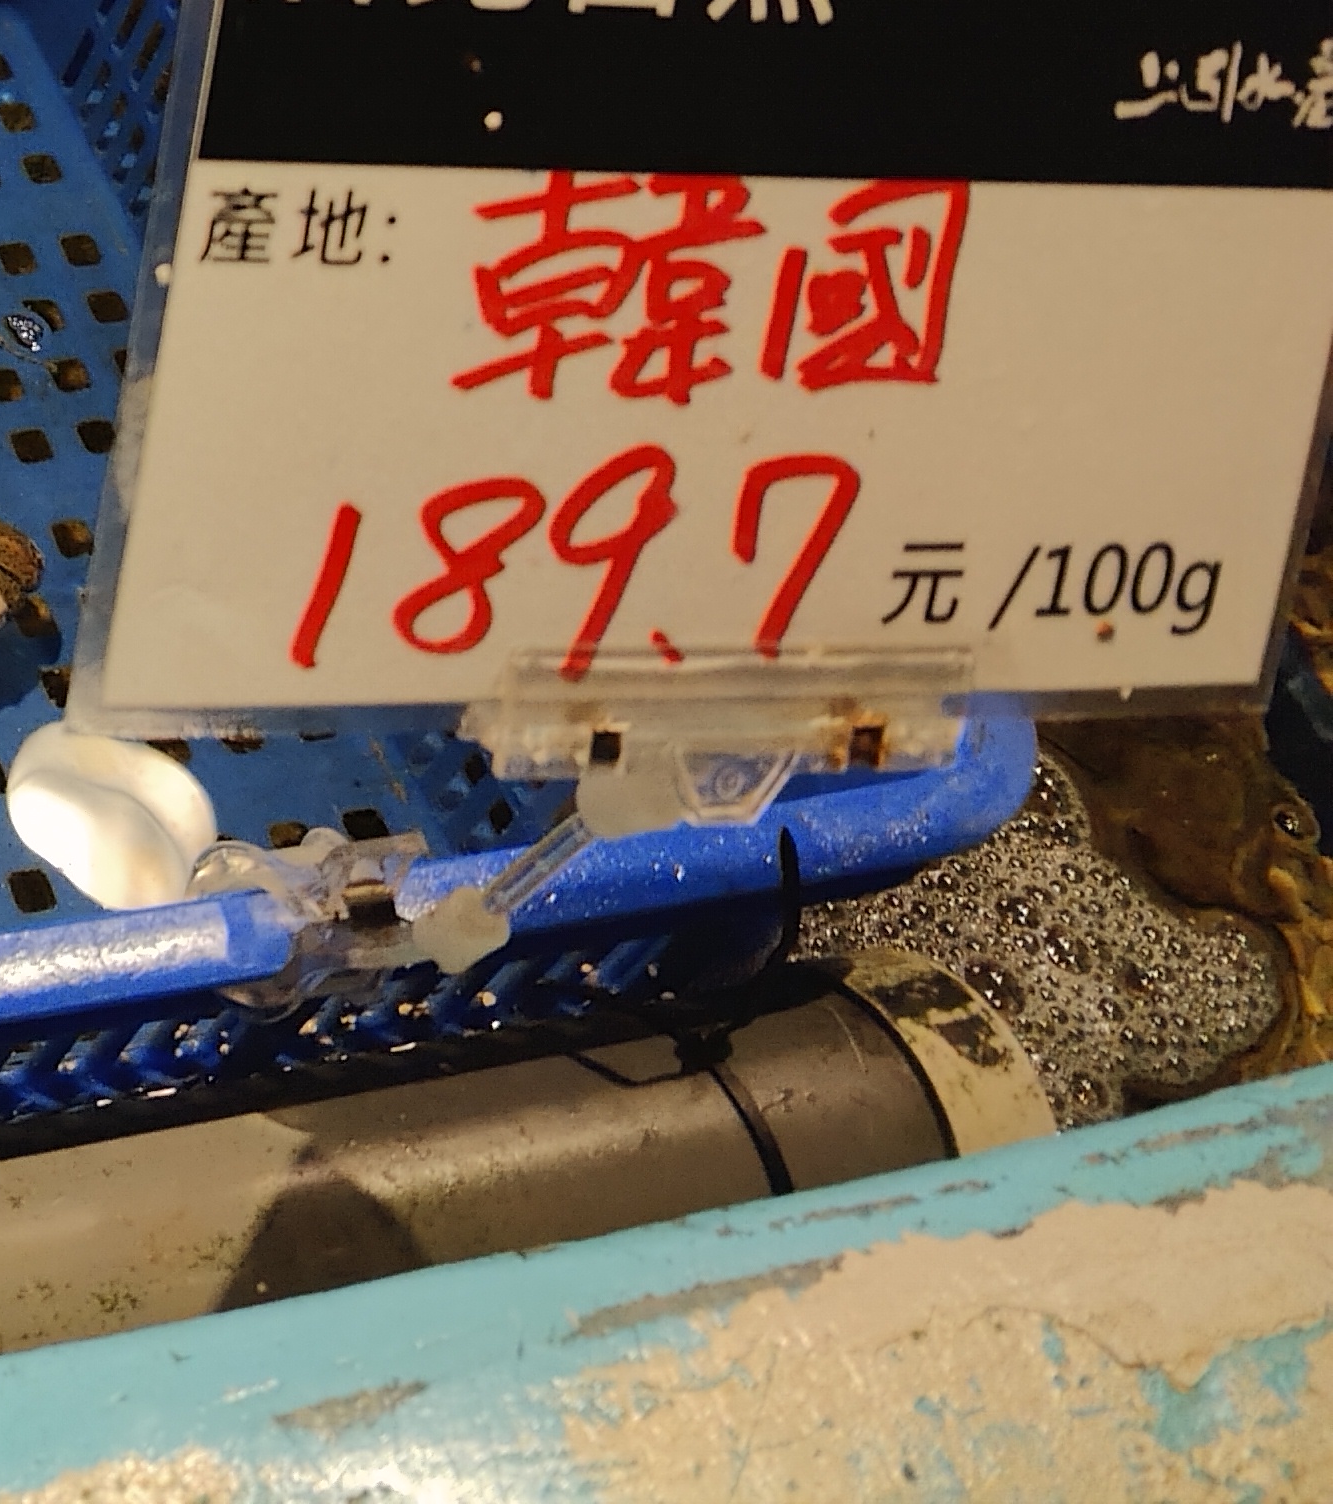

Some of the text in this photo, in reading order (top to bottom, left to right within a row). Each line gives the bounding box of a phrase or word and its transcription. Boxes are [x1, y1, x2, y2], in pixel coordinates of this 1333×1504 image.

[450, 169, 971, 407] 韓國
[287, 441, 862, 681] 189.7
[988, 540, 1223, 632] /100g
